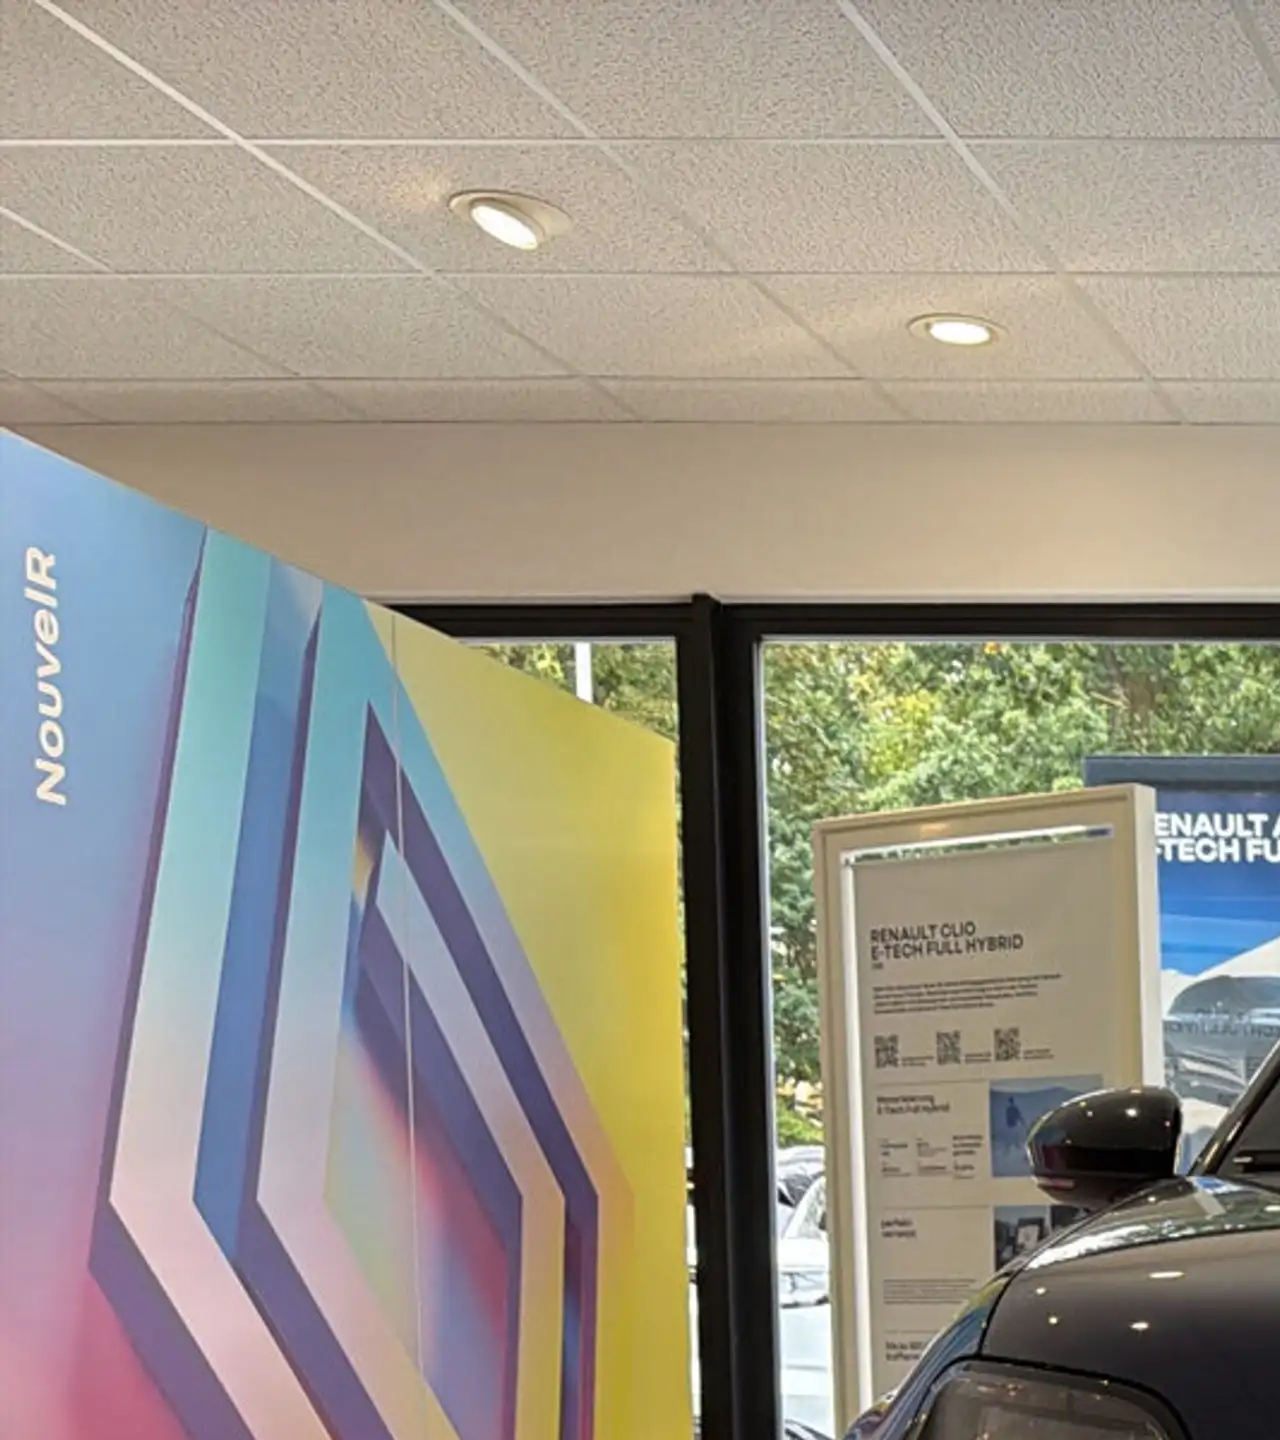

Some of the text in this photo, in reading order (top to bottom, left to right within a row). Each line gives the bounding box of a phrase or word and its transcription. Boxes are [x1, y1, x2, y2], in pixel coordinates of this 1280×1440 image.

[1153, 813, 1269, 839] ENAULT
[1156, 838, 1240, 863] -TECH
[870, 921, 976, 943] RENAULT CLIO
[870, 933, 1024, 961] E-TECH FULL HYBRID
